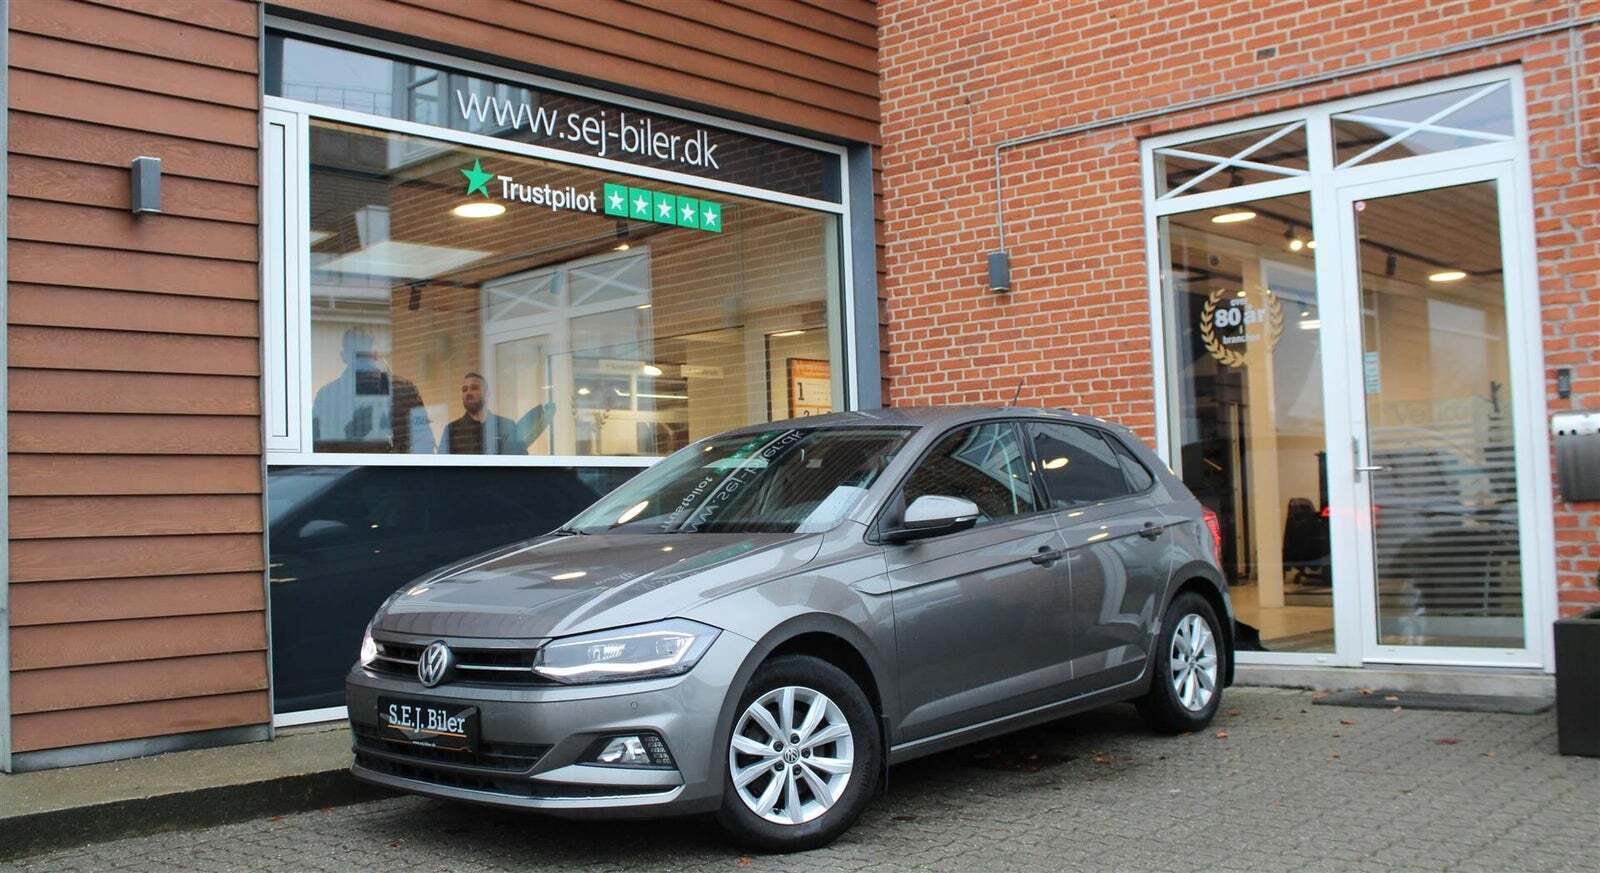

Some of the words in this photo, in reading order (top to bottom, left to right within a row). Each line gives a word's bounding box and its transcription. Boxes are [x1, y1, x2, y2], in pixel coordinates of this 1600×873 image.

[456, 89, 720, 170] www.sej-biler.dk
[497, 175, 597, 213] Trustpilot
[1214, 307, 1241, 328] 80
[797, 381, 806, 401] 1
[388, 704, 424, 732] S.E.J.
[427, 708, 465, 733] Biler
